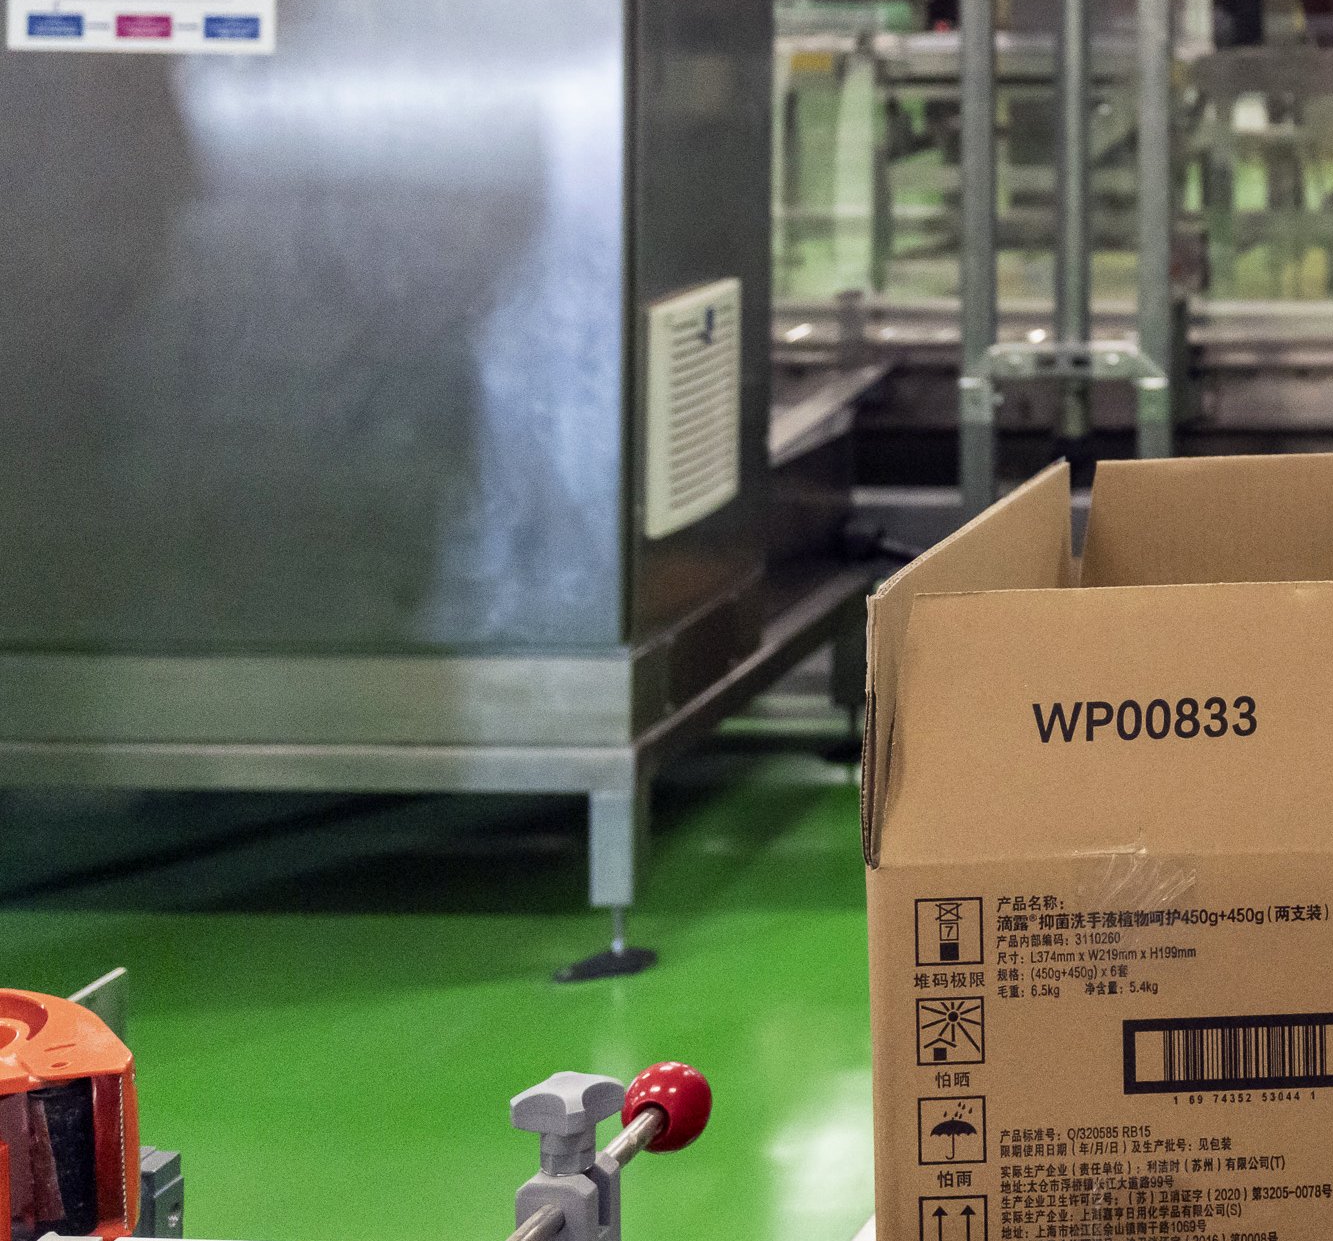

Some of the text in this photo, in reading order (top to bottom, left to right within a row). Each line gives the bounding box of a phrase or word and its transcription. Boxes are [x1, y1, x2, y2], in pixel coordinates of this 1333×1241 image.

[1032, 696, 1257, 743] WP00833
[997, 896, 1064, 912] 产品名称：
[944, 926, 951, 938] 7
[1088, 948, 1134, 961] W219mm
[1150, 946, 1196, 959] H199mm
[914, 971, 985, 989] 堆码极限
[935, 1072, 970, 1088] 怕晒
[1189, 1095, 1203, 1104] 69
[1213, 1093, 1251, 1104] 74352
[1262, 1091, 1300, 1102] 53044
[1122, 1125, 1151, 1138] RB15
[937, 1170, 973, 1188] 怕雨
